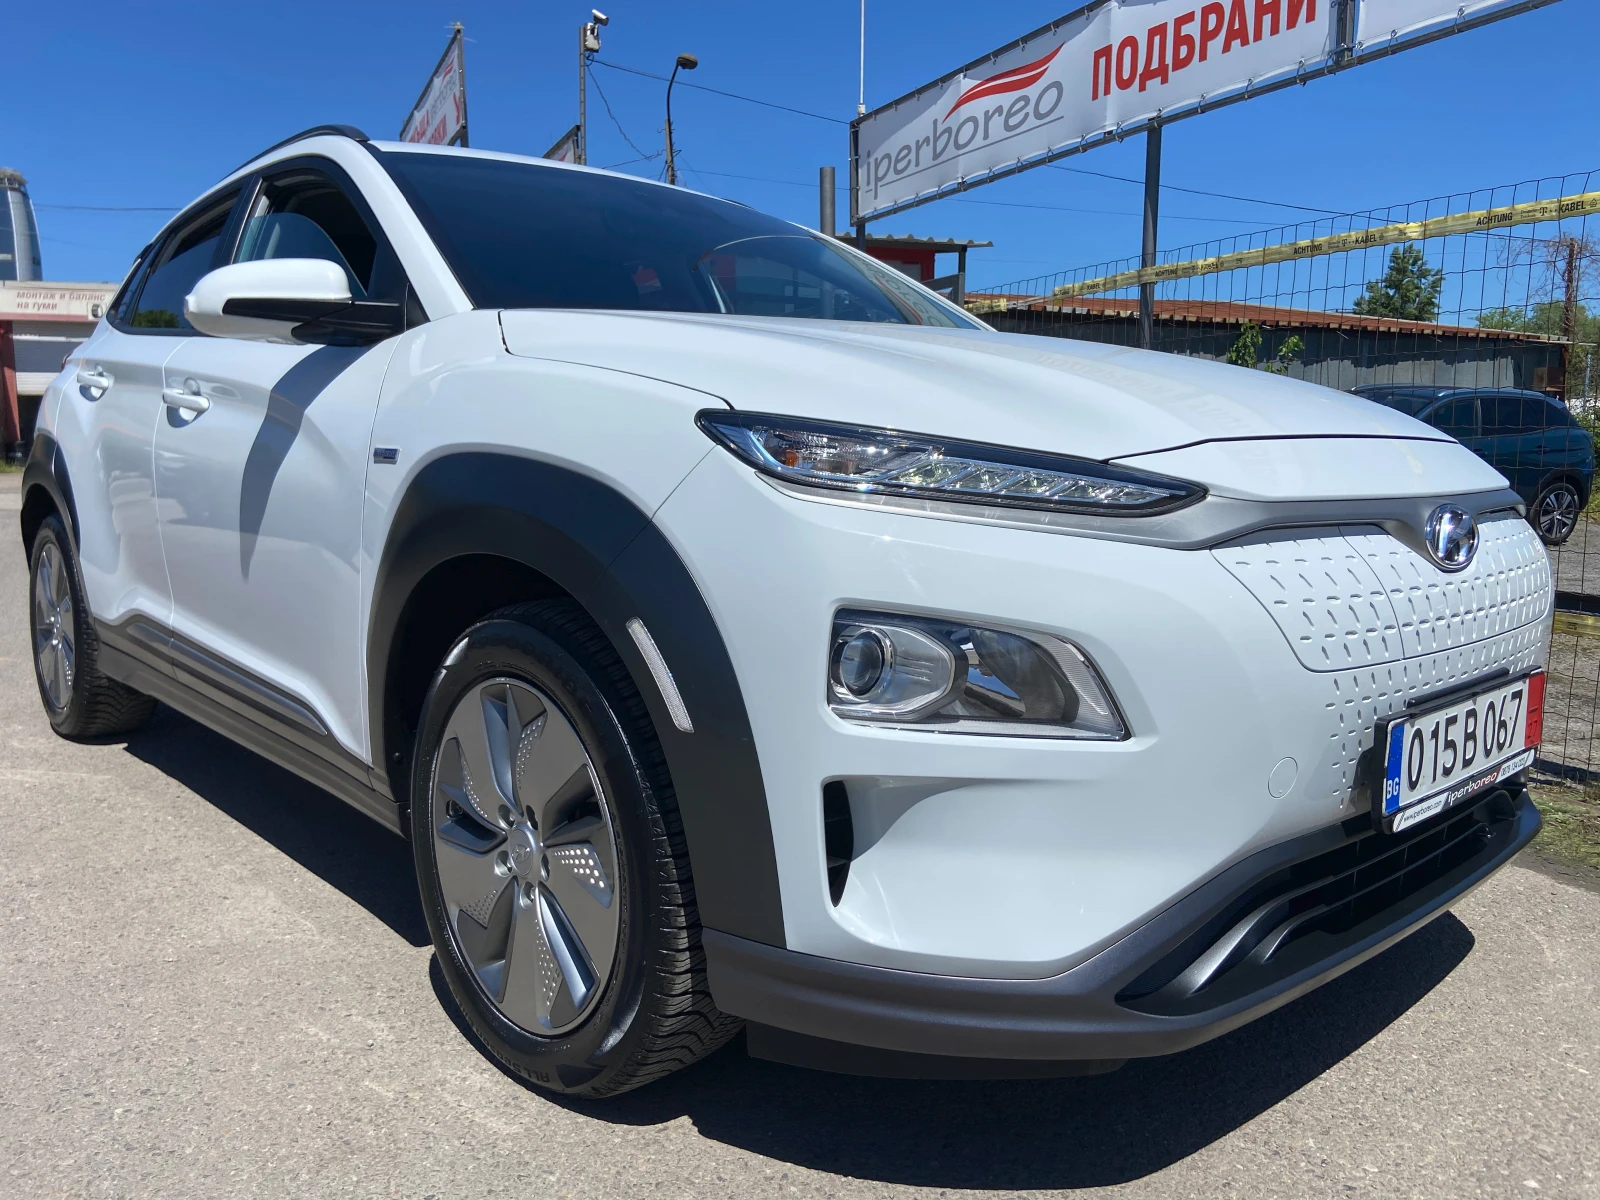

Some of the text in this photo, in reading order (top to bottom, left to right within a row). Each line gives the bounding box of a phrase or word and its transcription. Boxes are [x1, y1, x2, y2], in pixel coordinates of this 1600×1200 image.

[866, 80, 1064, 200] iperboreo
[1559, 200, 1586, 213] KABEL
[1476, 212, 1513, 226] ACHTUNG
[1354, 233, 1377, 245] KABEL
[1293, 243, 1323, 255] ACHTUNG
[16, 291, 56, 299] монтаж
[69, 291, 105, 301] баланс
[32, 302, 58, 311] гуми
[1386, 777, 1400, 800] BG
[1448, 772, 1498, 806] iperboreo
